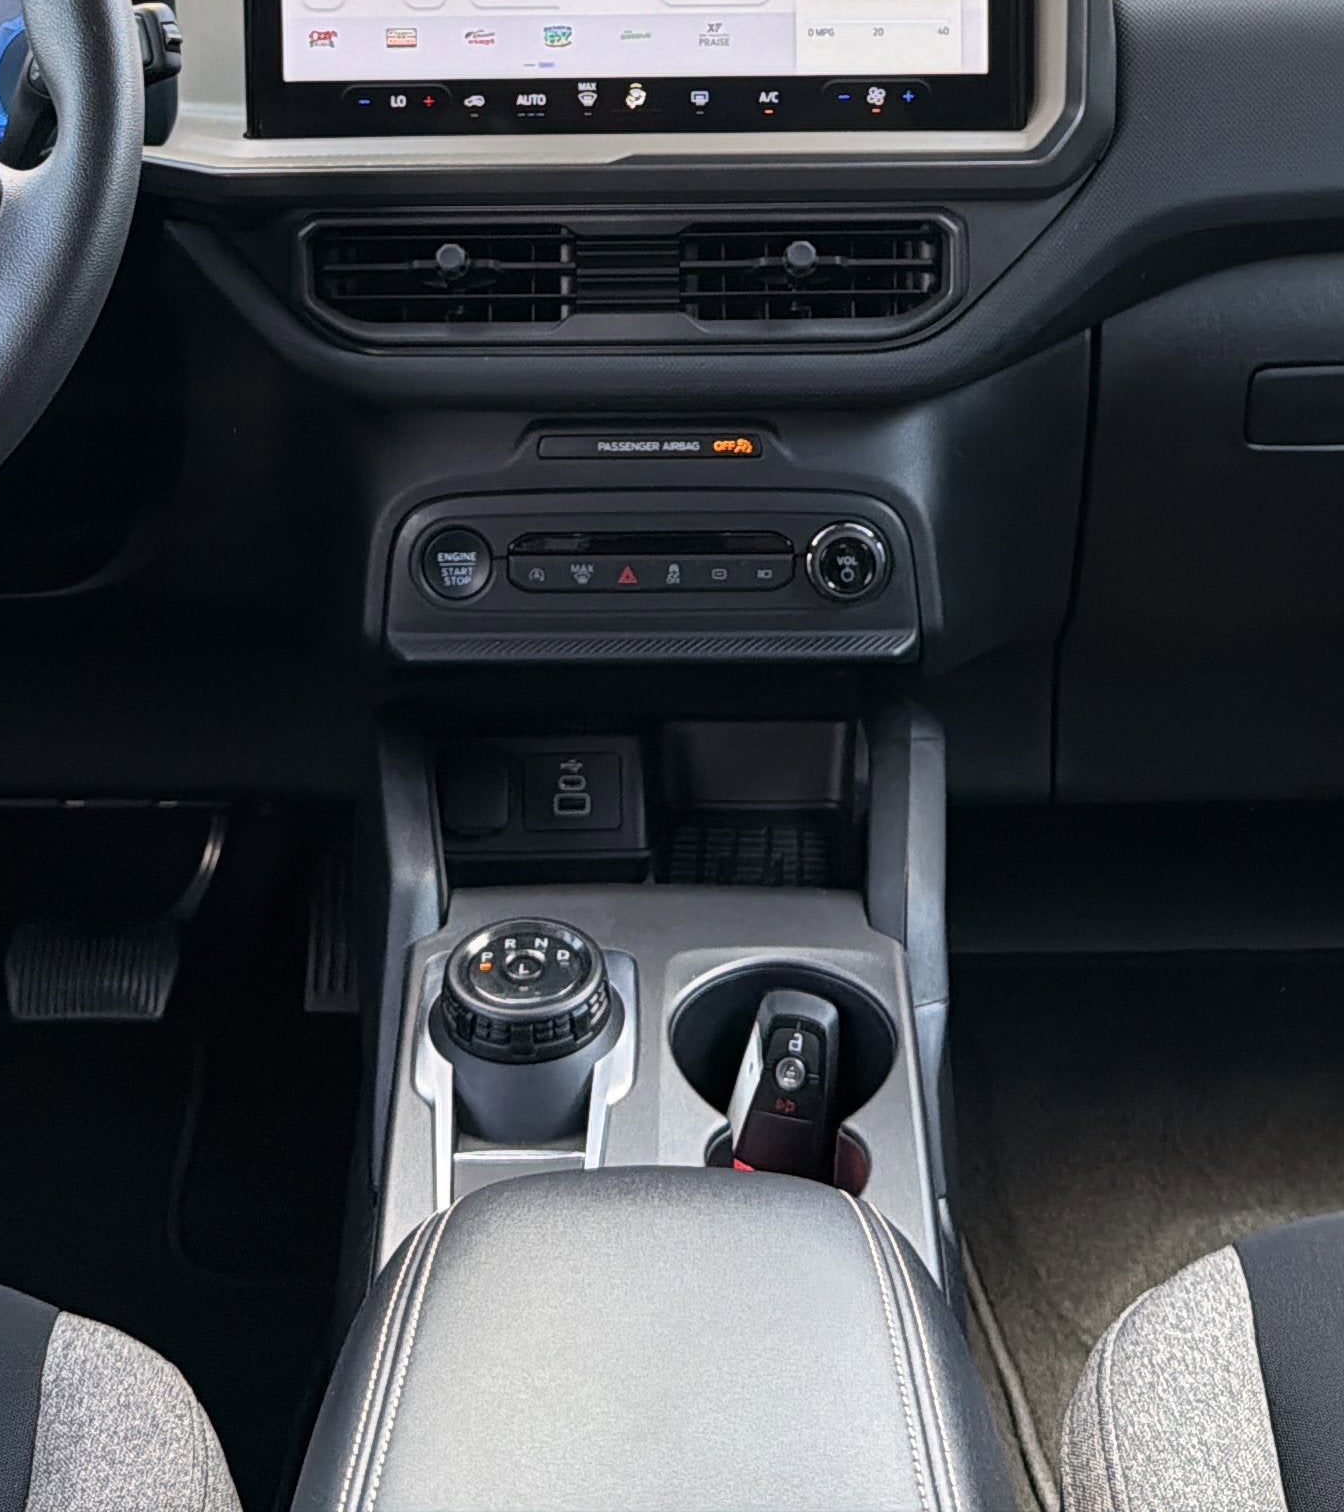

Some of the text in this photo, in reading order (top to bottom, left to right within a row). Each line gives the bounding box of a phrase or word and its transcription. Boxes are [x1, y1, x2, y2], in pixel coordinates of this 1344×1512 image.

[873, 28, 885, 37] 20
[937, 27, 950, 36] 40
[698, 37, 730, 47] PRAISE
[578, 82, 597, 90] MAX
[391, 95, 406, 107] LO
[516, 94, 546, 106] AUTO
[759, 91, 779, 104] A/C
[597, 440, 736, 452] PASSENGER AIRBAG OFF
[437, 551, 477, 562] ENGINE
[837, 556, 857, 566] VOL
[441, 568, 473, 577] START
[570, 564, 594, 573] MAX
[443, 577, 471, 586] STOP
[504, 938, 516, 949] R
[534, 937, 548, 948] N
[481, 951, 494, 963] P
[556, 949, 570, 961] D
[519, 963, 530, 975] L
